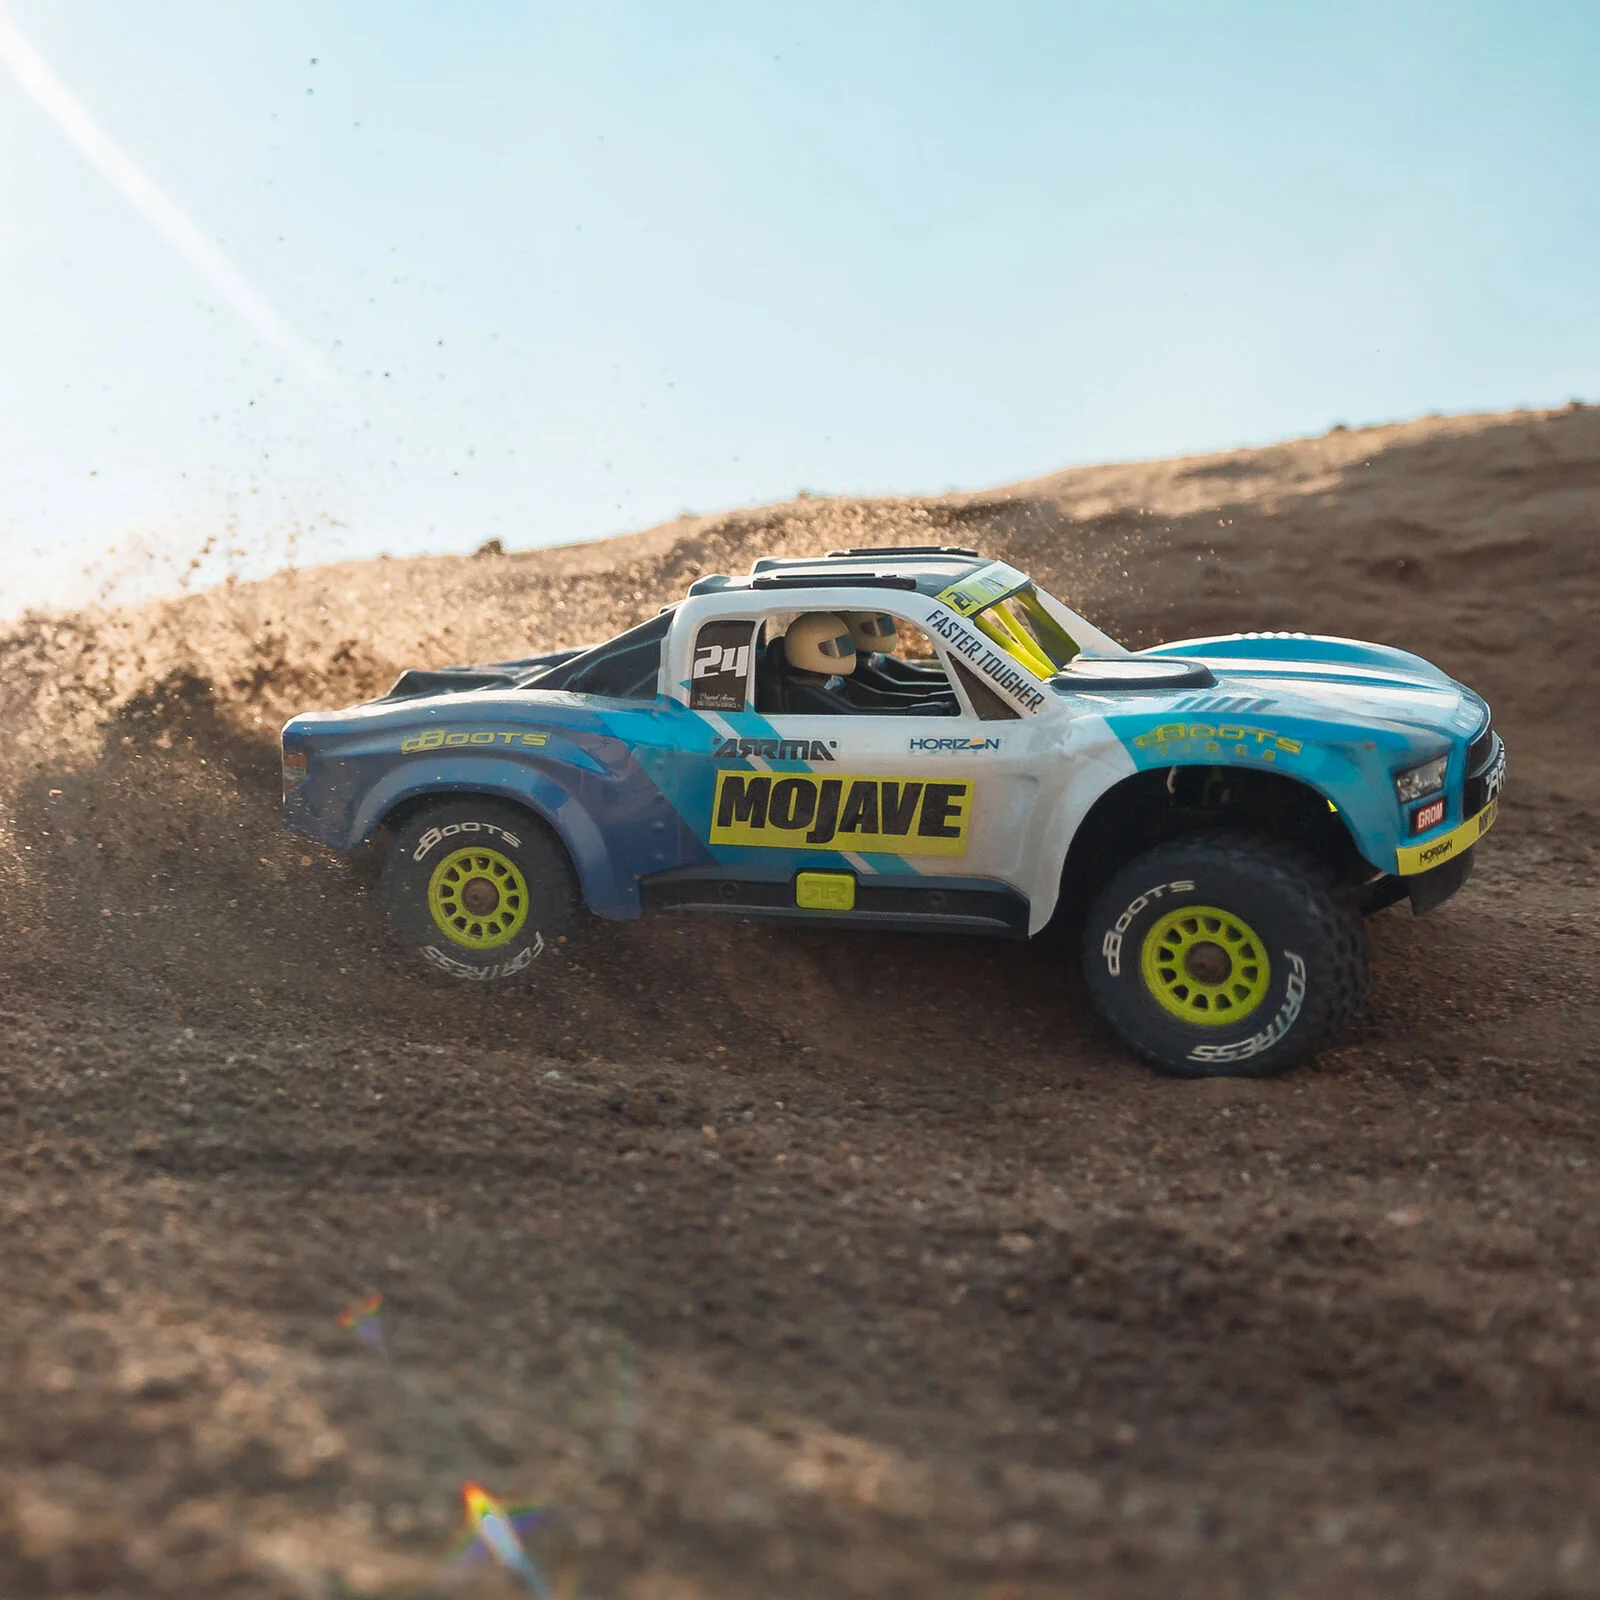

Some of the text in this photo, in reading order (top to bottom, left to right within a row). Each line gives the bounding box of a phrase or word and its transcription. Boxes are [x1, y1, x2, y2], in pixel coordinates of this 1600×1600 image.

[693, 645, 750, 679] 24
[926, 609, 1045, 714] FASTER. TOUGHER.
[910, 738, 1000, 750] HORIZON
[717, 776, 967, 844] MOJAVE
[1417, 802, 1443, 829] GROM
